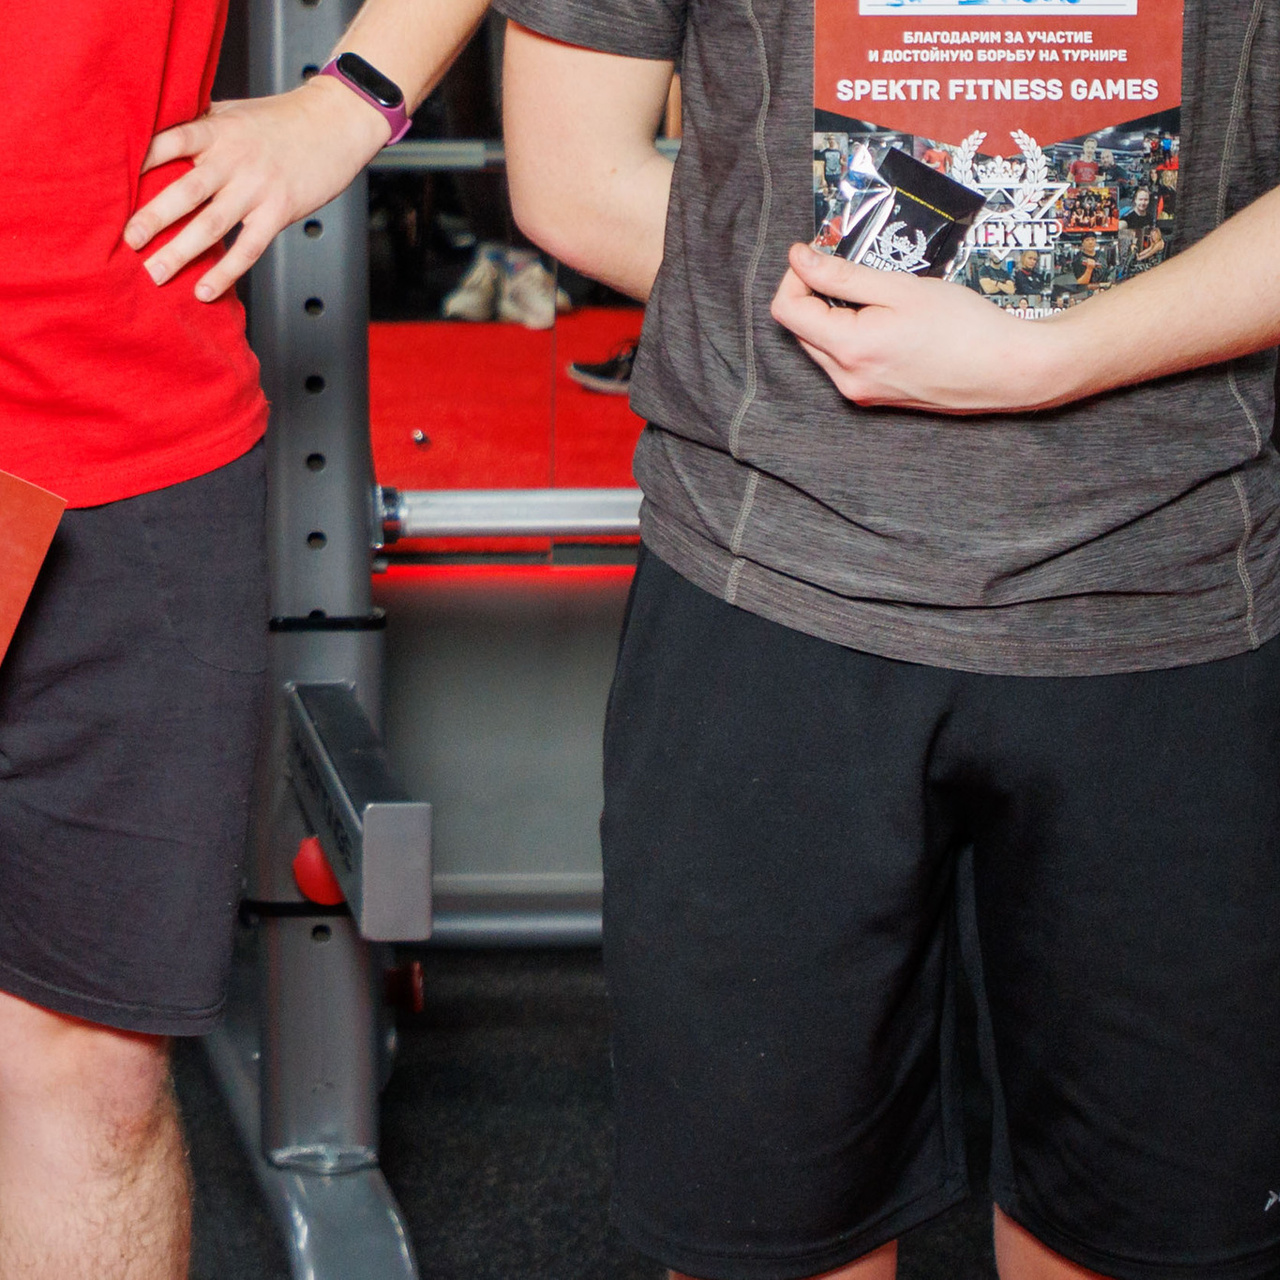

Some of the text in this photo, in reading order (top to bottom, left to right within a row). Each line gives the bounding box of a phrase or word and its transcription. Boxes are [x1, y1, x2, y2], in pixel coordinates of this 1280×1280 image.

[903, 30, 1093, 45] БЛАГОДАРИМ ЗА УЧАСТИЕ
[868, 47, 1127, 64] И ДОСТОЙНУЮ БОРЬБУ НА ТУРНИРЕ
[836, 78, 1159, 101] SPEKTR FITNESS GAMES
[972, 221, 1061, 247] ЕКТР
